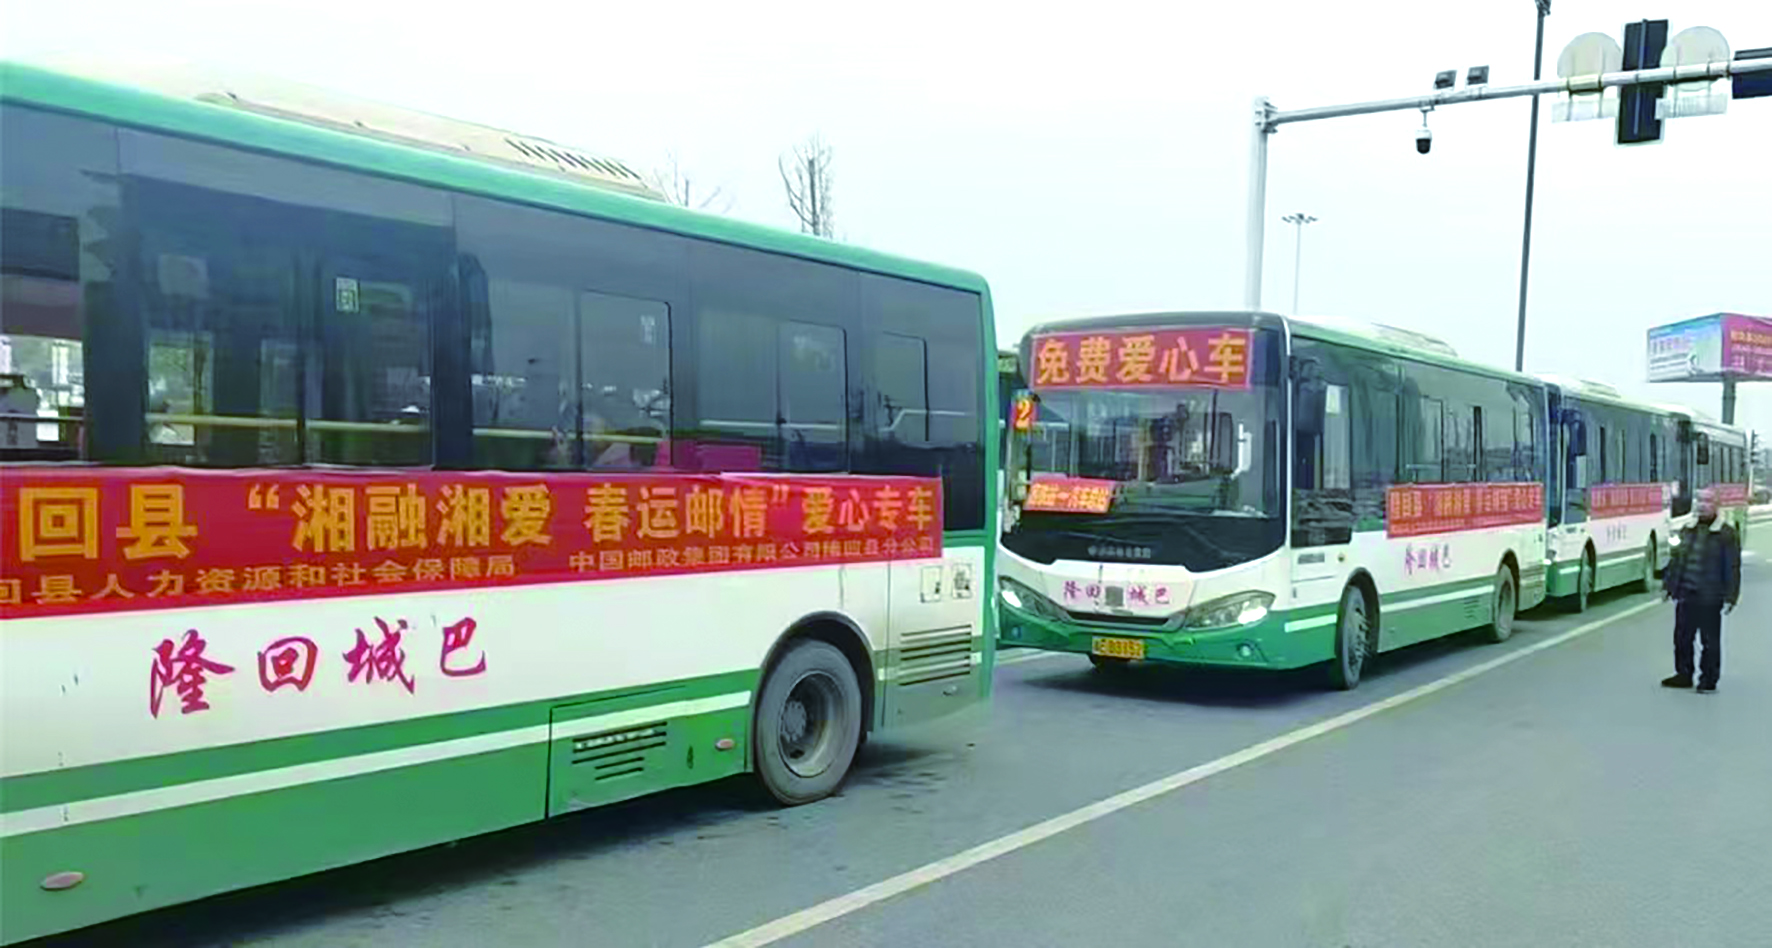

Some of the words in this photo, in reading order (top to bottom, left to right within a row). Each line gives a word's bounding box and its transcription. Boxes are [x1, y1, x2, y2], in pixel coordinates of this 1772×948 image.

[1036, 332, 1247, 384] 免费爱心车
[18, 483, 198, 561] 回县
[150, 616, 487, 719] 隆回城巴
